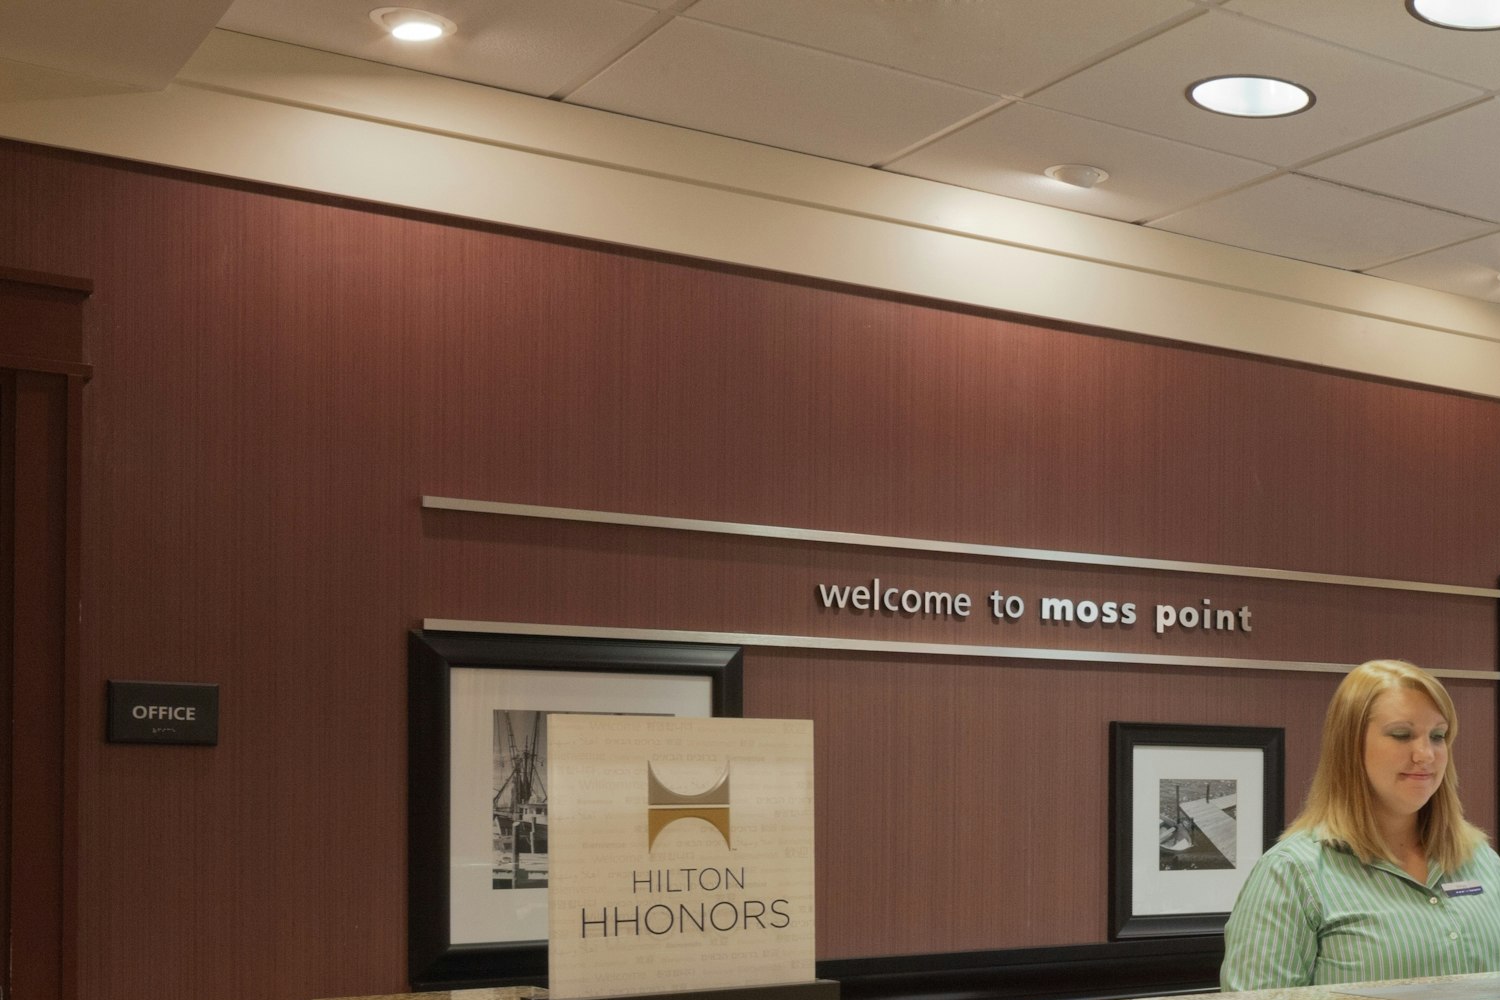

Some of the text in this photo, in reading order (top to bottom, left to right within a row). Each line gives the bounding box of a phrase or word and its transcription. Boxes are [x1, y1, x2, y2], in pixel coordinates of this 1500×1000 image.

[818, 578, 1253, 634] welcome to moss point
[132, 705, 196, 720] OFFICE
[633, 866, 745, 894] HILTON
[582, 899, 790, 938] HHONORS
